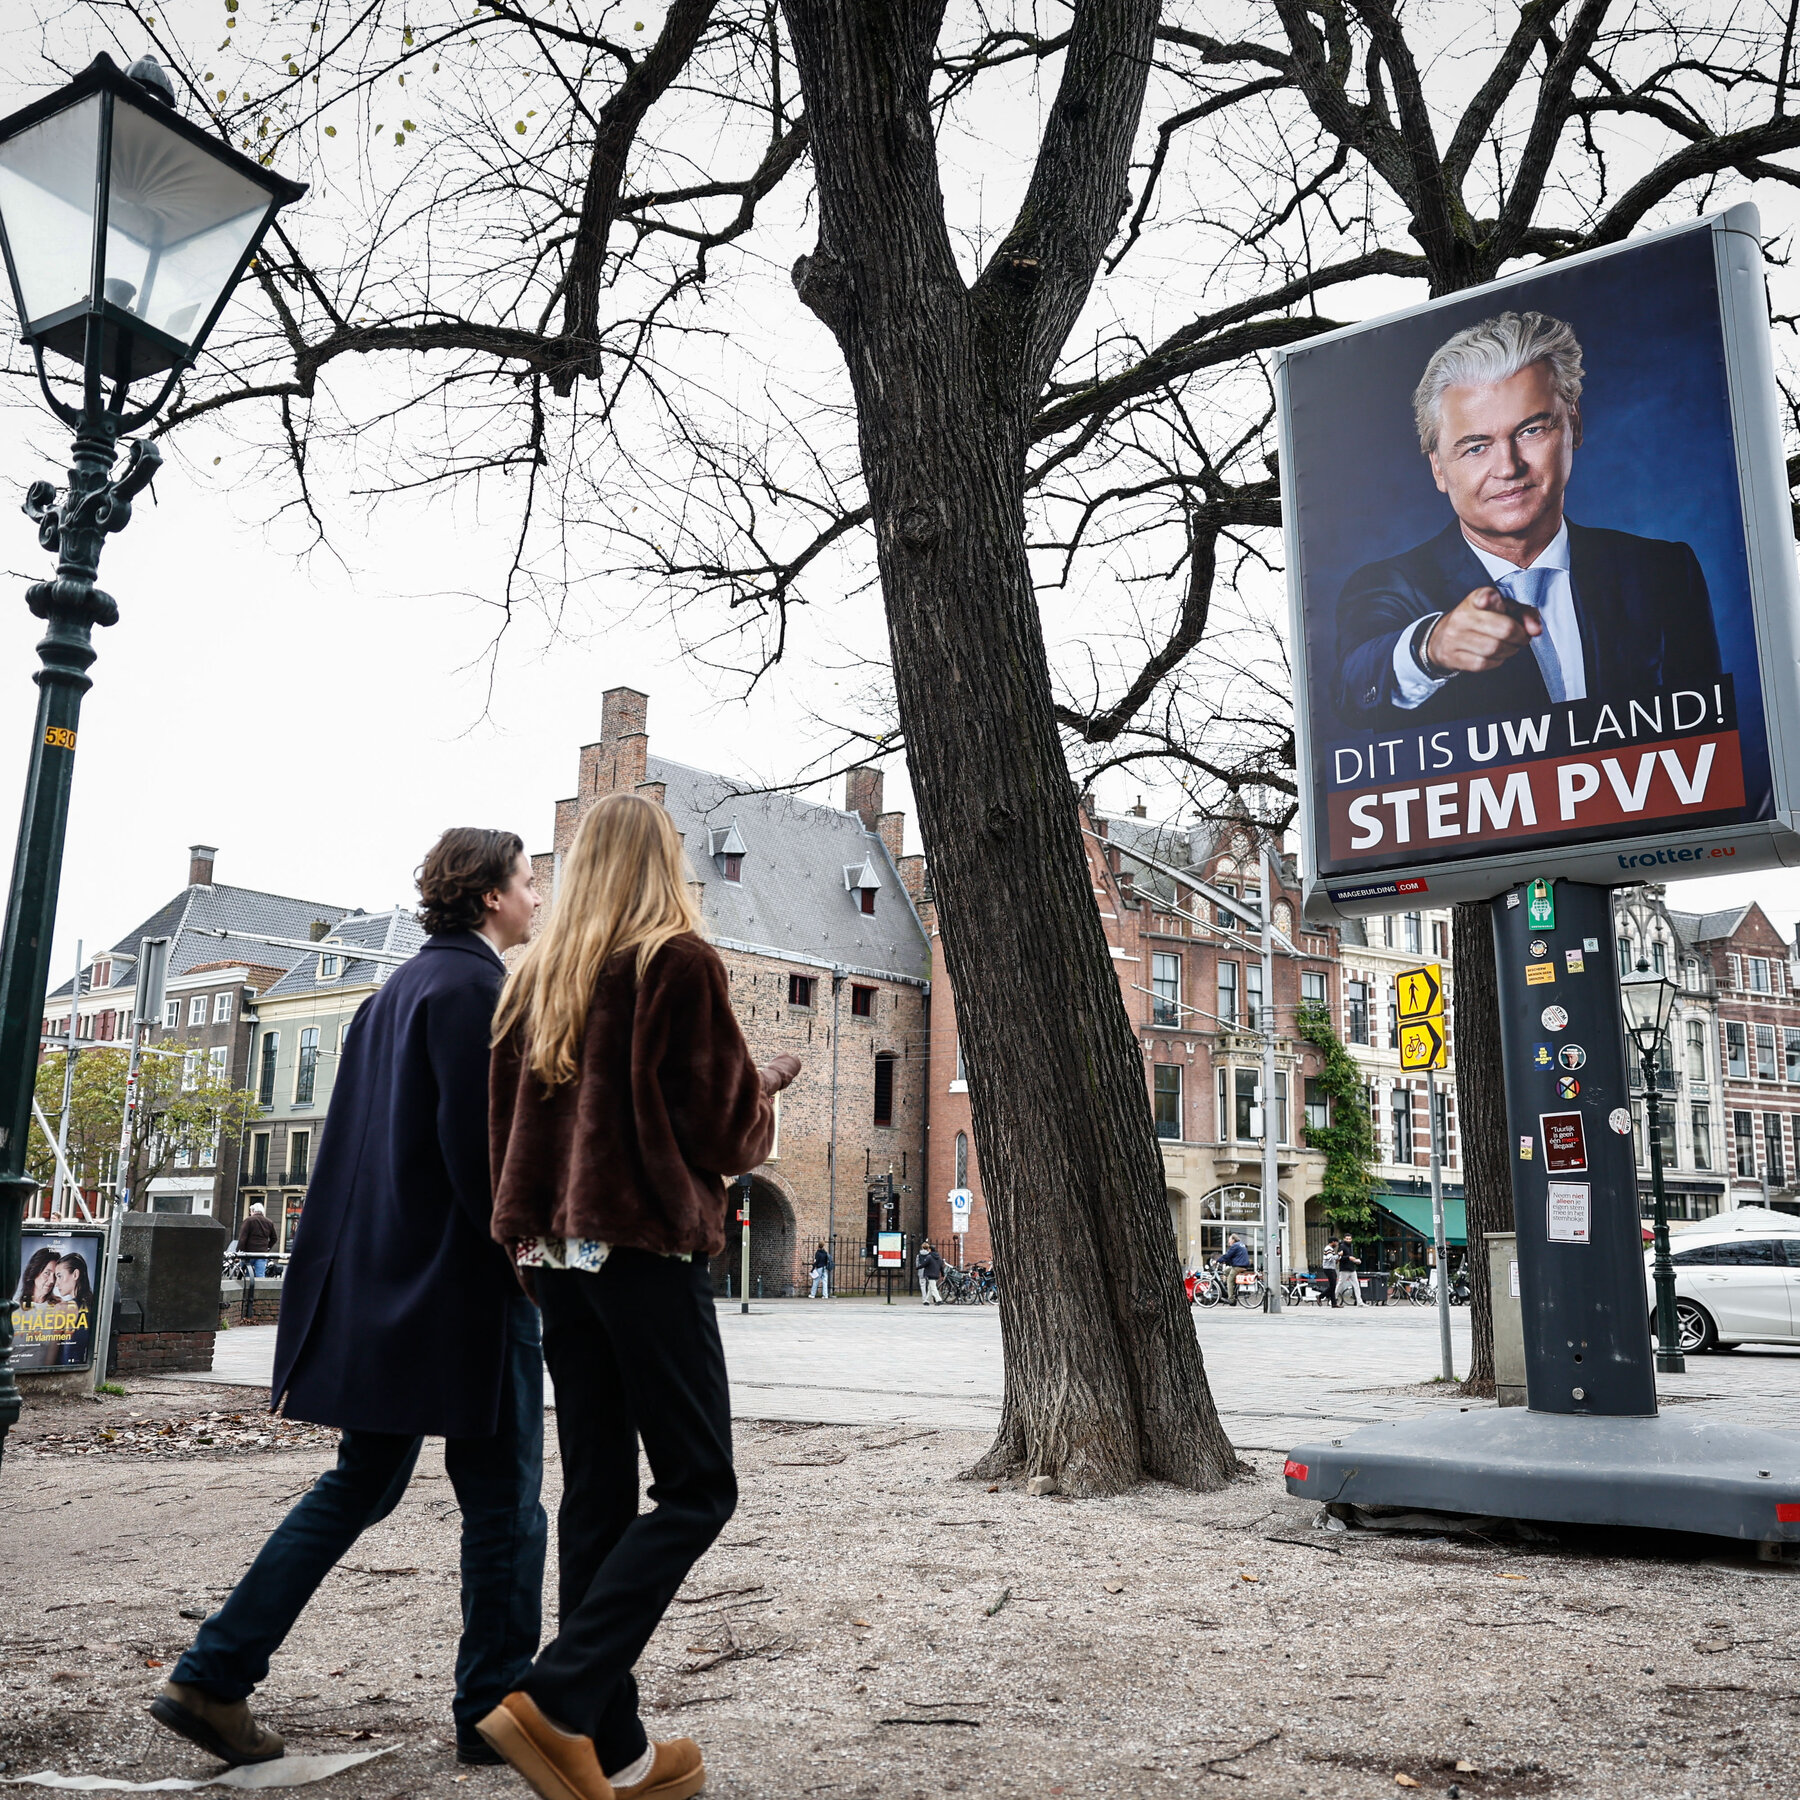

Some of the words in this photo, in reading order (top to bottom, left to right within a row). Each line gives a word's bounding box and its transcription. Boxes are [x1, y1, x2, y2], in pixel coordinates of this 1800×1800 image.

[45, 728, 76, 748] 530
[1334, 739, 1404, 784] DIT
[1418, 732, 1454, 770] IS
[1467, 714, 1551, 762] UW
[1568, 684, 1724, 747] LAND!
[1348, 771, 1538, 850] STEM
[1557, 742, 1717, 821] PVV
[1617, 845, 1736, 869] trotter.eu
[11, 1313, 88, 1330] PHAEDRA
[26, 1334, 33, 1342] in
[35, 1333, 71, 1342] vlammen
